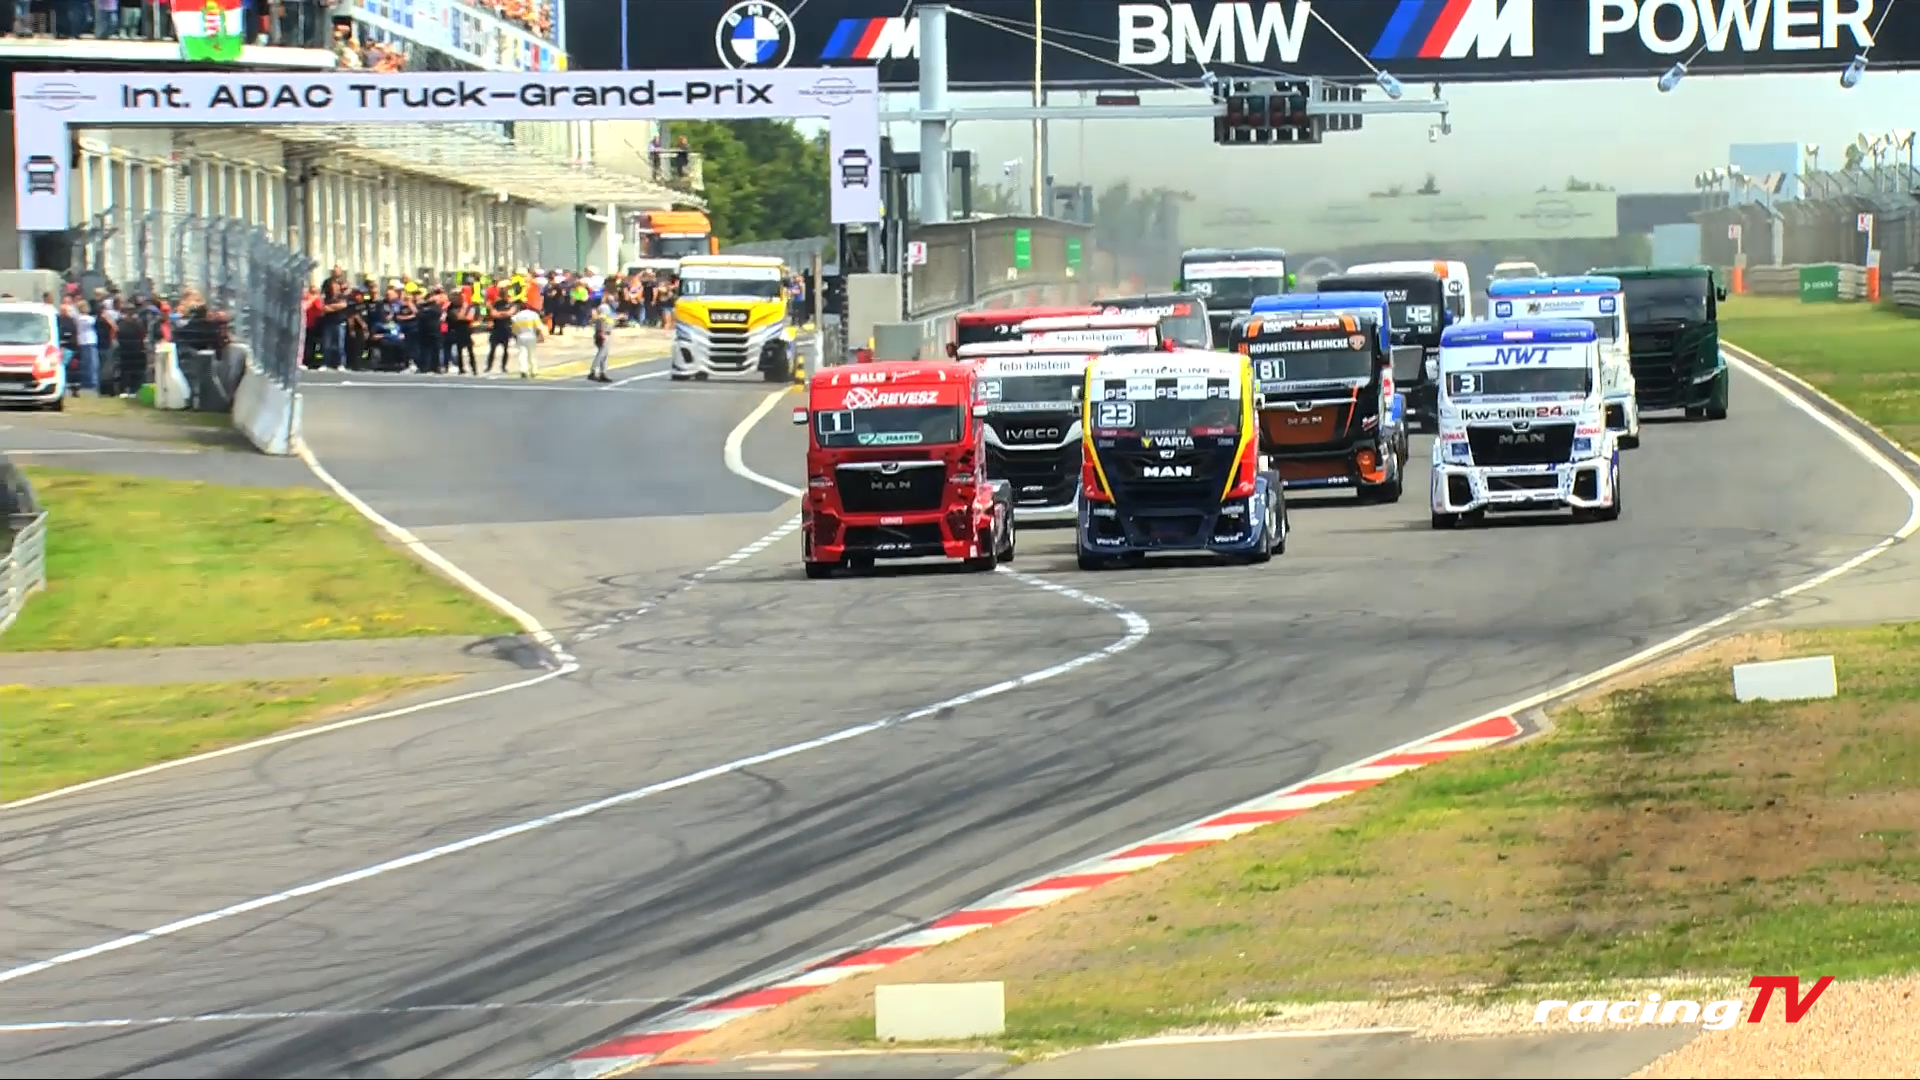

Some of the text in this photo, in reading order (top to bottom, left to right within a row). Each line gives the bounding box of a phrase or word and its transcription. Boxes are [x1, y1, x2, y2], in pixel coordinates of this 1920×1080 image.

[726, 4, 785, 29] BMW
[1117, 3, 1311, 65] BMW
[1588, 0, 1876, 55] POWER
[122, 84, 191, 109] Int.
[208, 85, 333, 109] ADAC
[1406, 305, 1432, 323] 42
[1250, 342, 1302, 353] HOFMEISTER
[1311, 338, 1349, 350] MEINCKE
[1494, 347, 1549, 364] NWT
[1000, 360, 1071, 371] febi bilstein
[1260, 359, 1281, 379] 81
[1460, 374, 1475, 393] 3
[1102, 405, 1132, 425] 23
[1461, 406, 1580, 420] lkw-teile24.de
[1006, 429, 1059, 439] IVECO
[1155, 437, 1194, 447] VARTA
[1499, 434, 1545, 444] MAN
[1143, 466, 1192, 478] MAN
[871, 481, 911, 489] MAN
